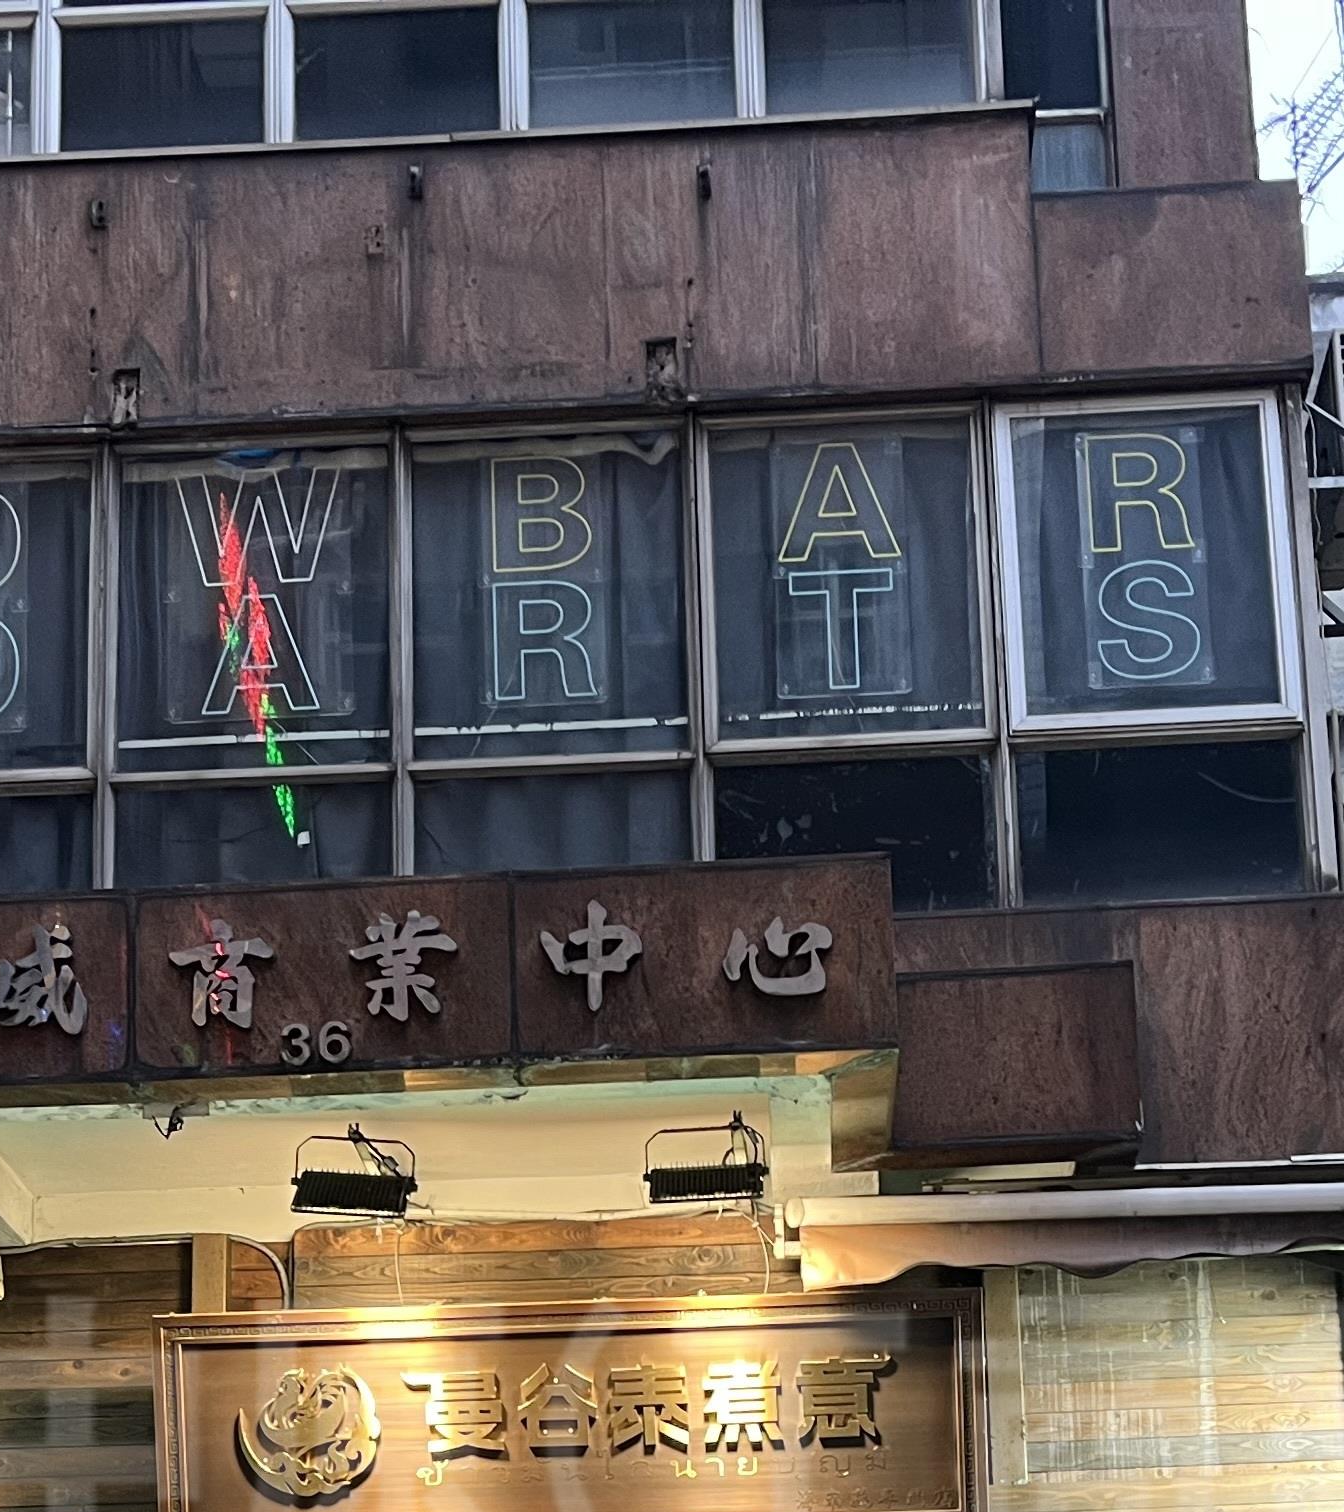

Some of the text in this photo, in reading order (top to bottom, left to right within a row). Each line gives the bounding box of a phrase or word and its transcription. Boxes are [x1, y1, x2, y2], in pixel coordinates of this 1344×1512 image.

[281, 1021, 351, 1064] 36
[400, 1353, 889, 1460] 曼谷泰煮意
